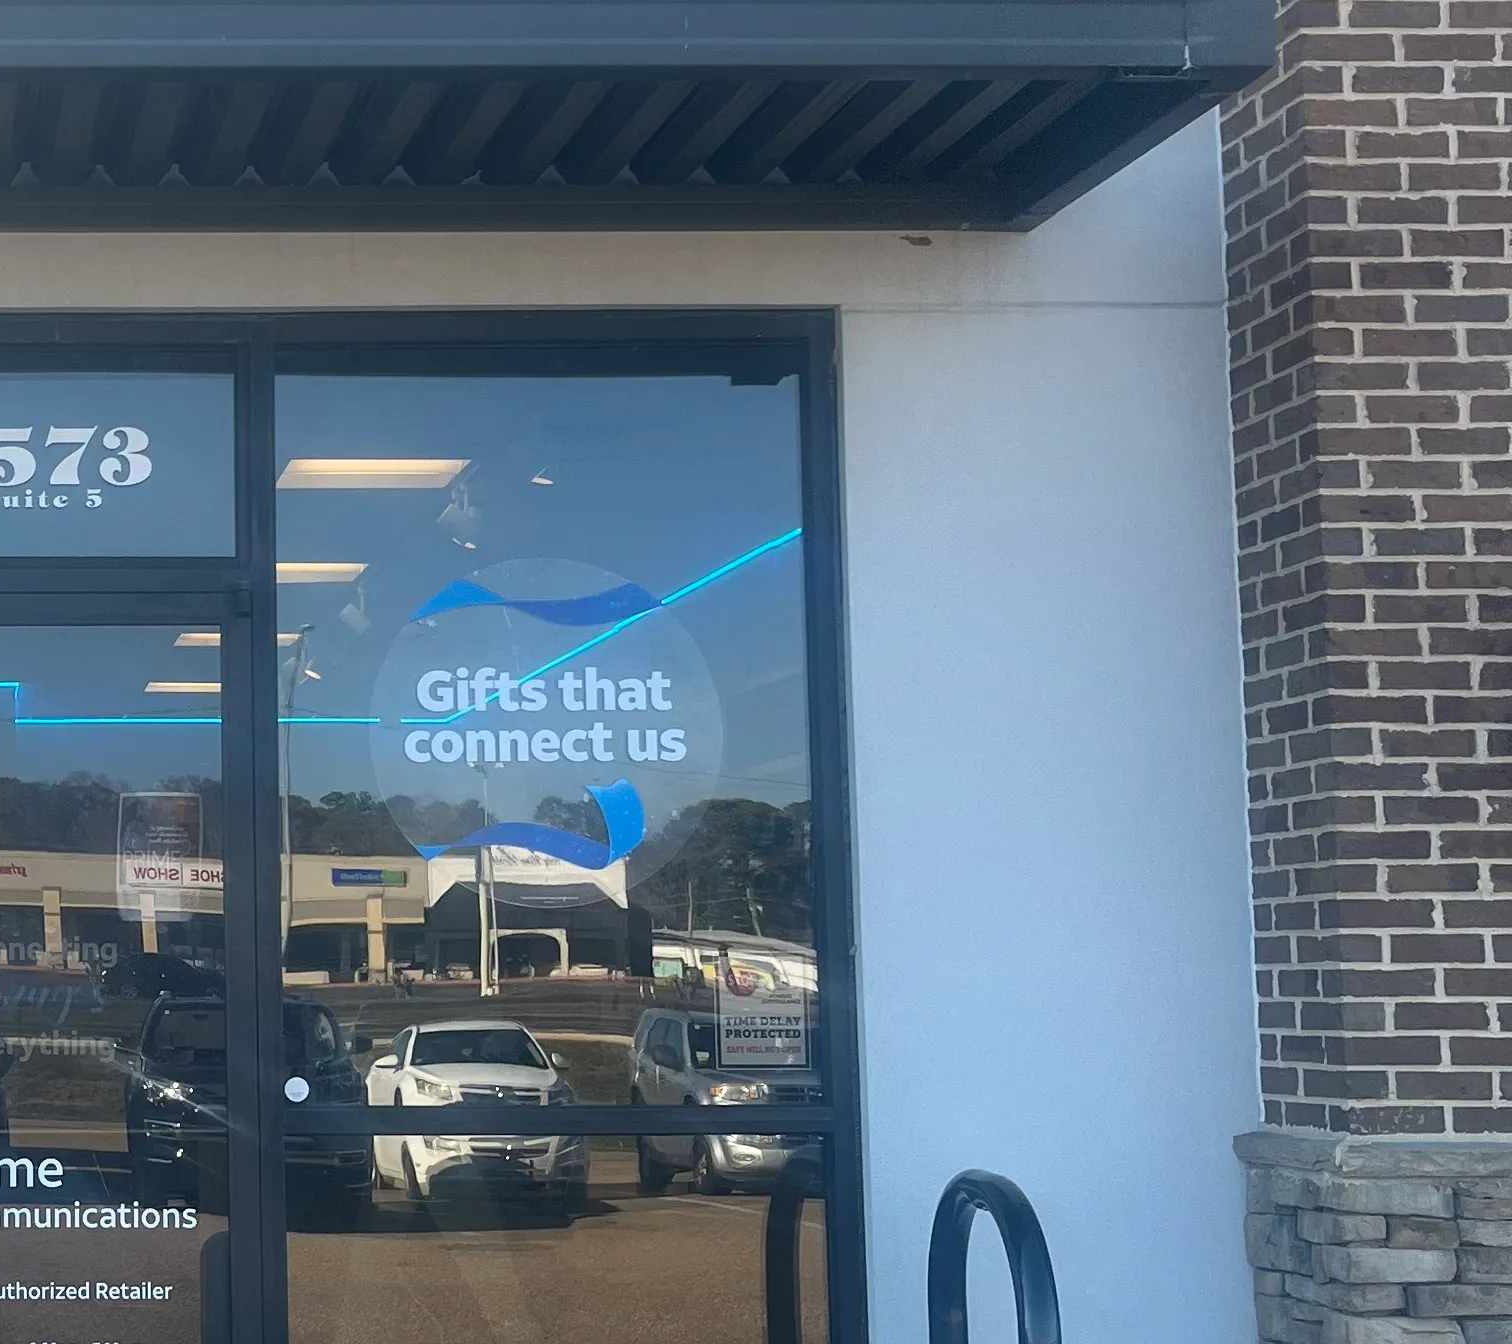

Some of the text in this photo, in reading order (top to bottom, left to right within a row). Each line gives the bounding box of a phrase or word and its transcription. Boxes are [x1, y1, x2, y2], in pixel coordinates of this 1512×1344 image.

[86, 489, 103, 509] 5
[416, 666, 672, 712] Gifts that
[403, 722, 687, 764] connect us
[724, 1016, 801, 1026] TIME DELAY
[725, 1028, 801, 1039] PROTECTED
[95, 1281, 174, 1301] Retailer
